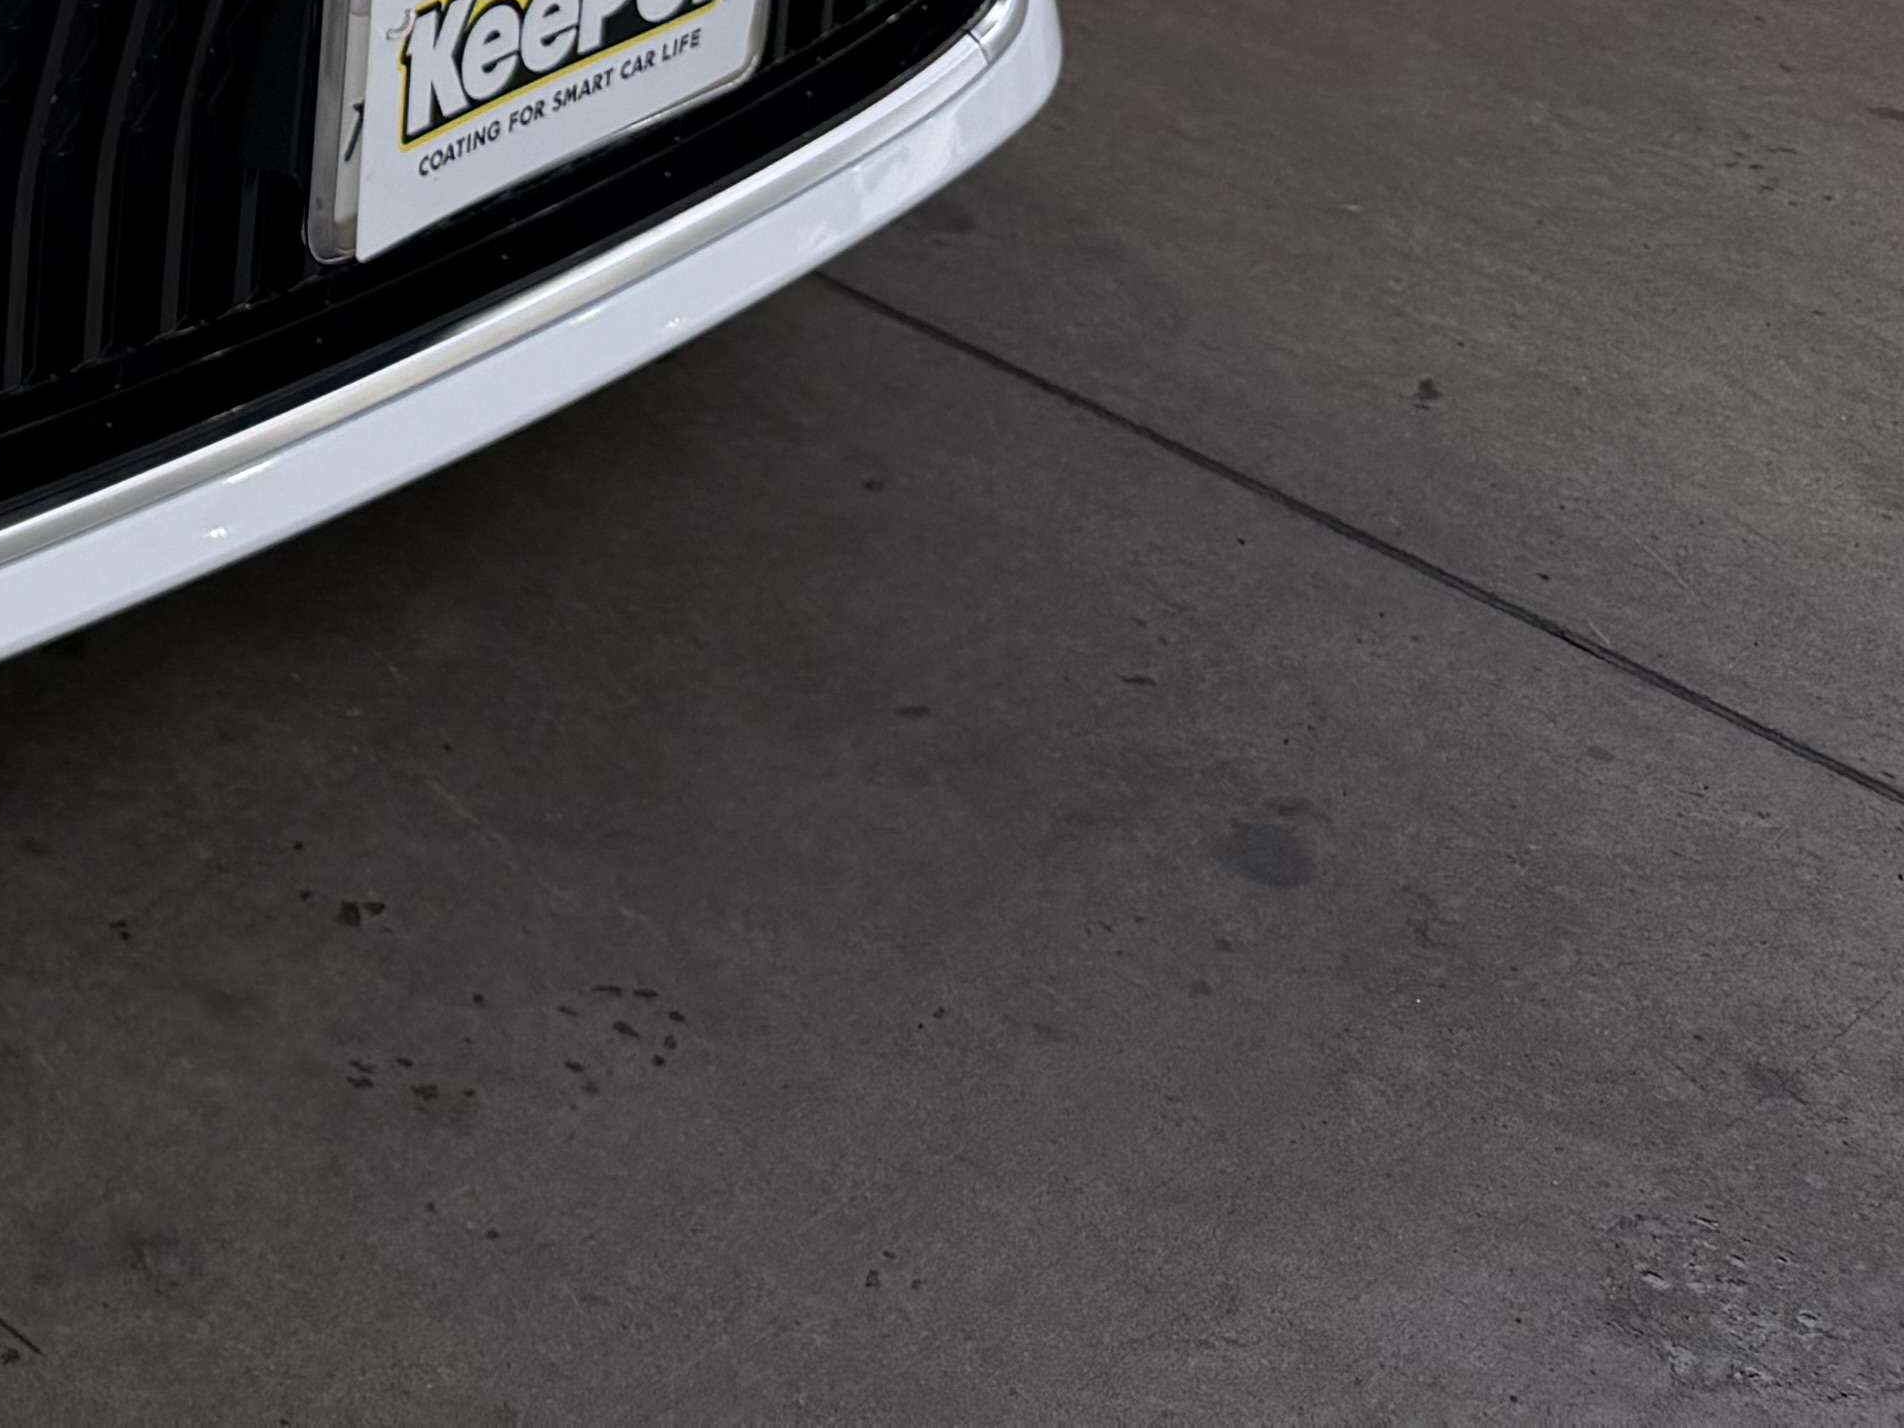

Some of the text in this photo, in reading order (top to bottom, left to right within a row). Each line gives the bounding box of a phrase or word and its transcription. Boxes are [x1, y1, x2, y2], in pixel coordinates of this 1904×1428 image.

[418, 27, 703, 177] COATING FOR SMART CAR LIFE
